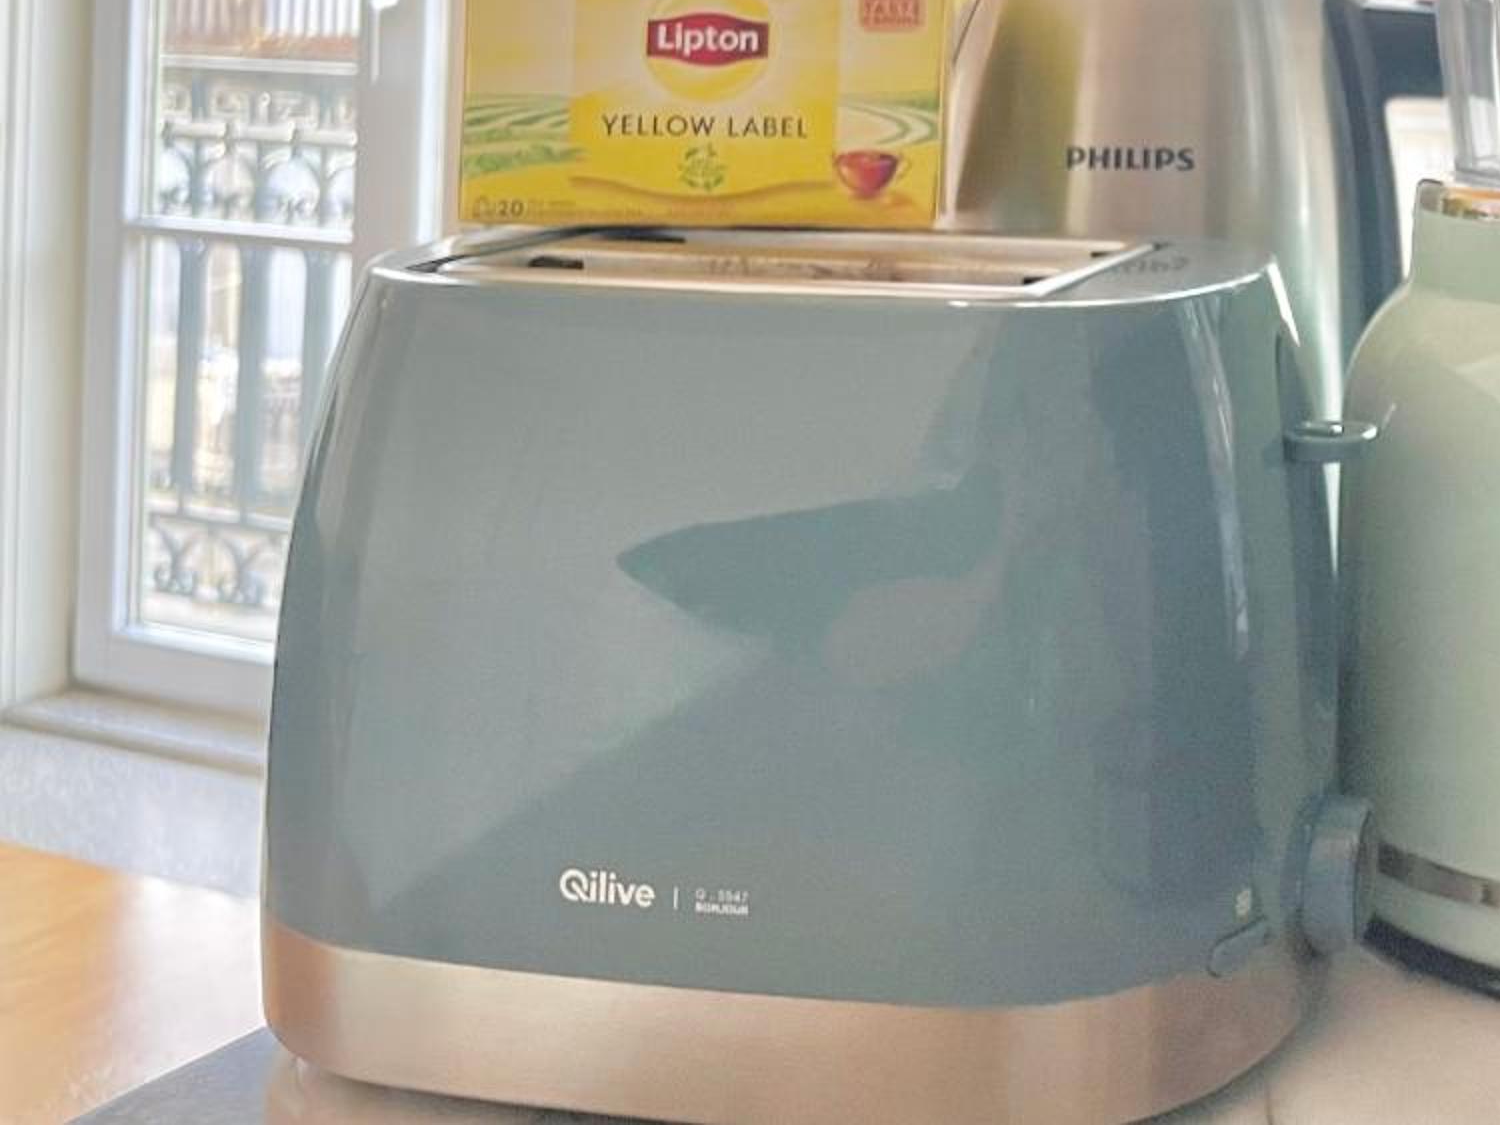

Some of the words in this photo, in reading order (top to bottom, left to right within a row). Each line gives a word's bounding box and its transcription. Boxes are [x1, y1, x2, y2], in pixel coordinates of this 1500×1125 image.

[656, 22, 759, 57] Lipton
[602, 113, 716, 138] YELLOW
[727, 115, 808, 139] LABEL
[1065, 146, 1195, 172] PHILIPS
[498, 199, 524, 218] 20
[559, 868, 656, 908] Qilive
